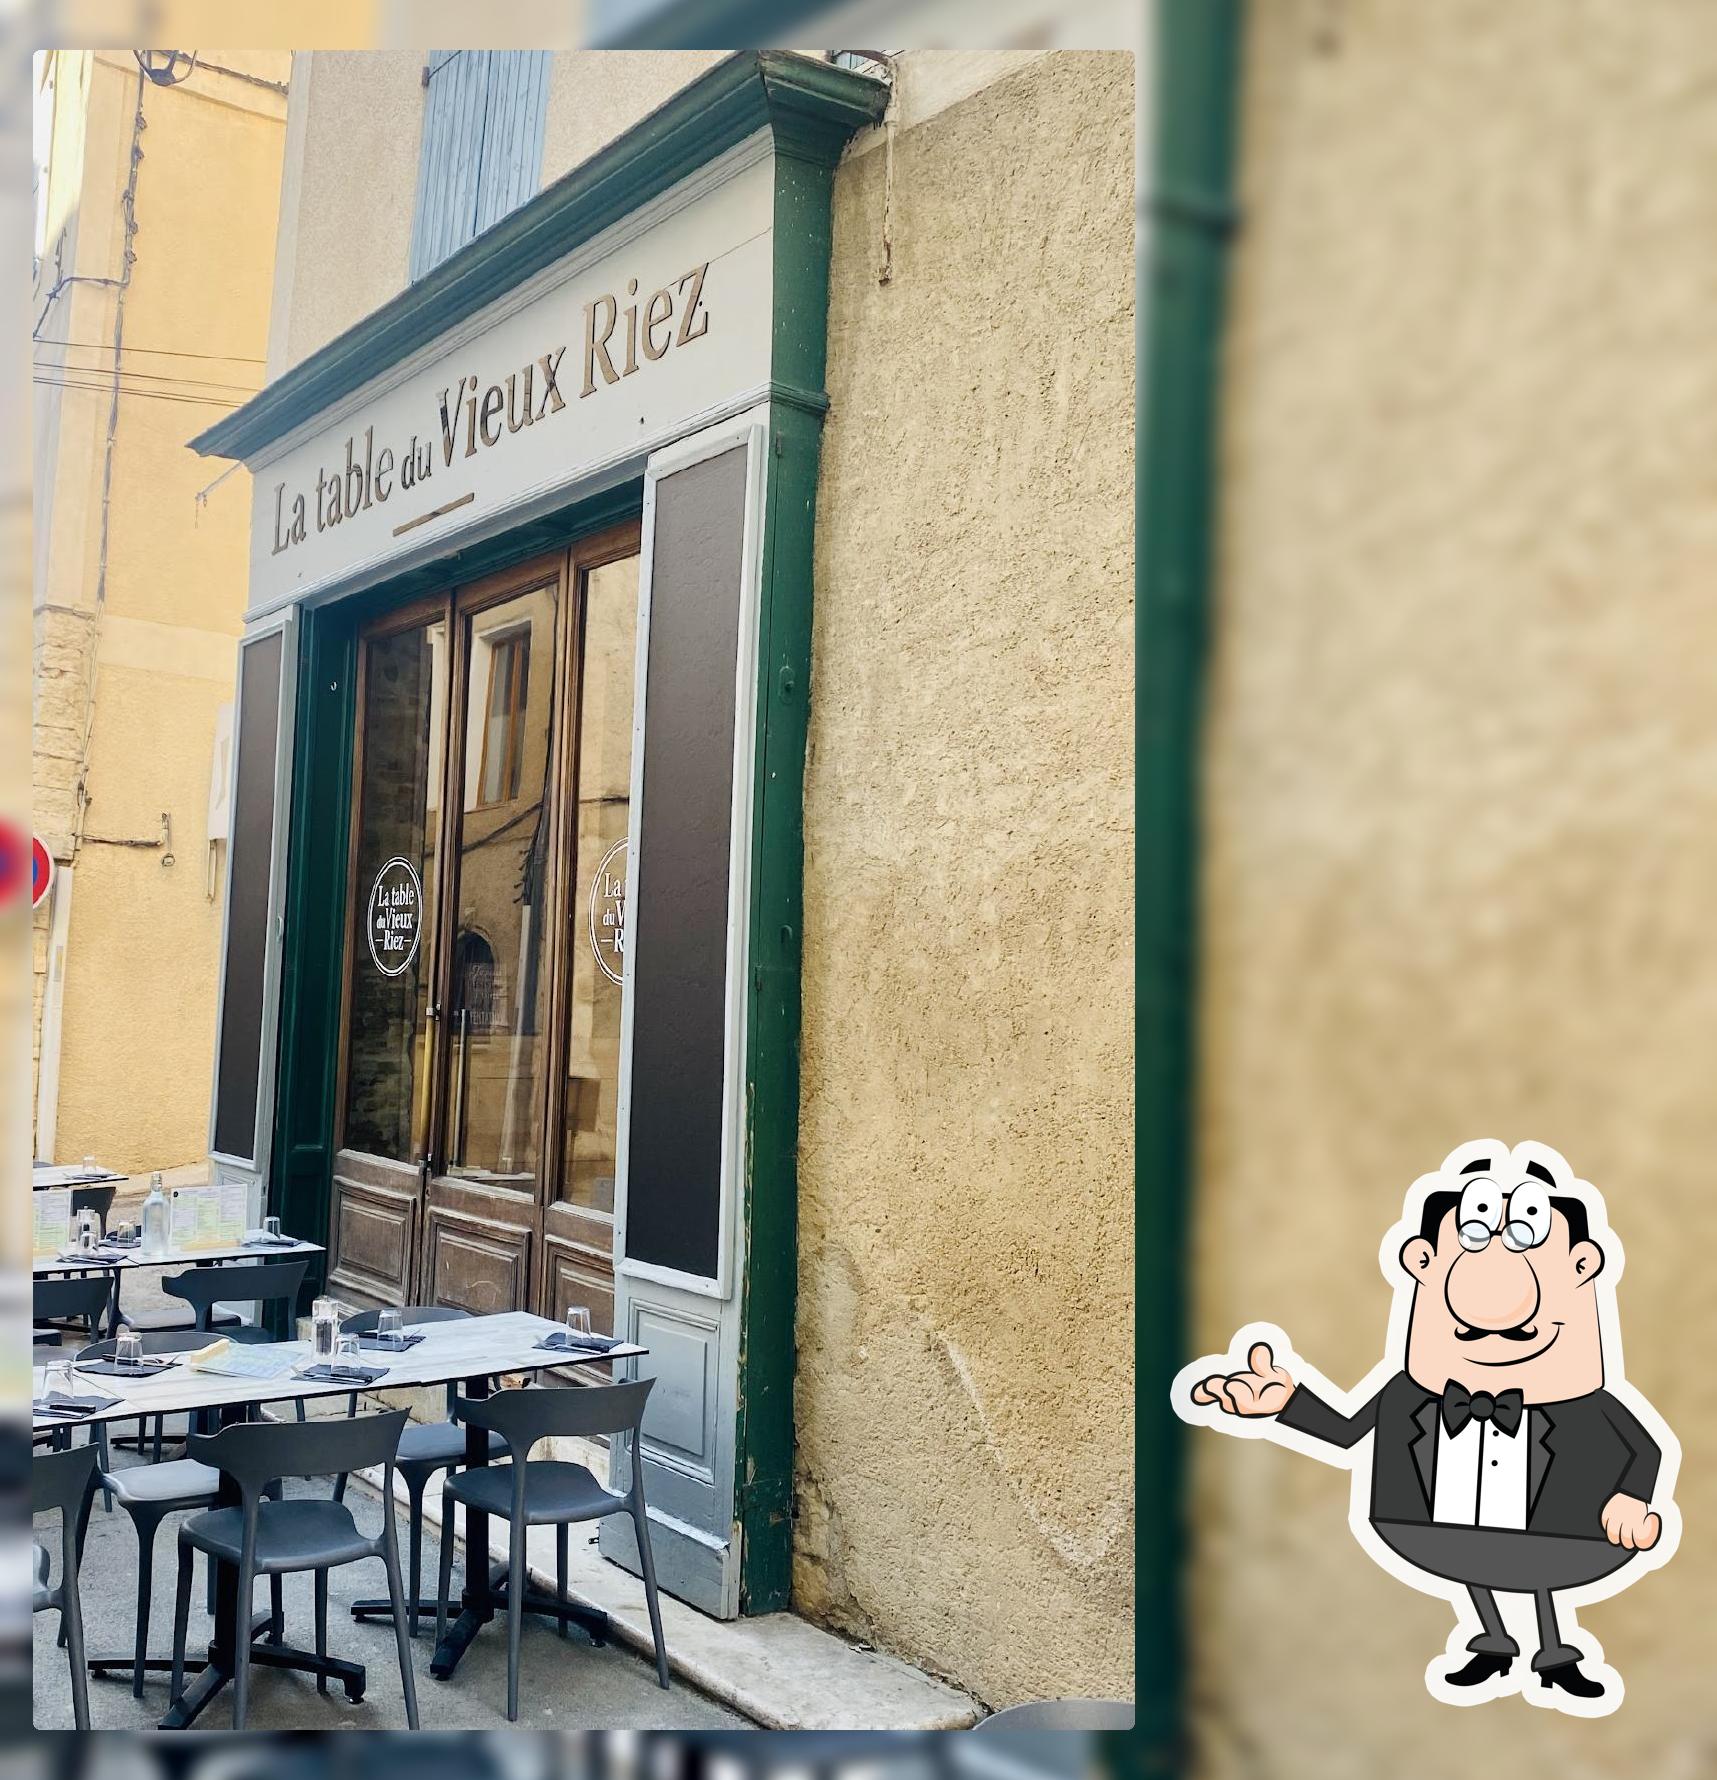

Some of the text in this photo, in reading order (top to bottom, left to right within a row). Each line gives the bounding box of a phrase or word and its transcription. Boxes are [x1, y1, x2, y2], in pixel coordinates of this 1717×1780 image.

[271, 262, 710, 556] La table du Vieux Riez
[378, 883, 414, 907] La table
[604, 873, 621, 898] La
[376, 908, 412, 929] du Vieux
[603, 909, 615, 926] du
[383, 929, 404, 951] Riez
